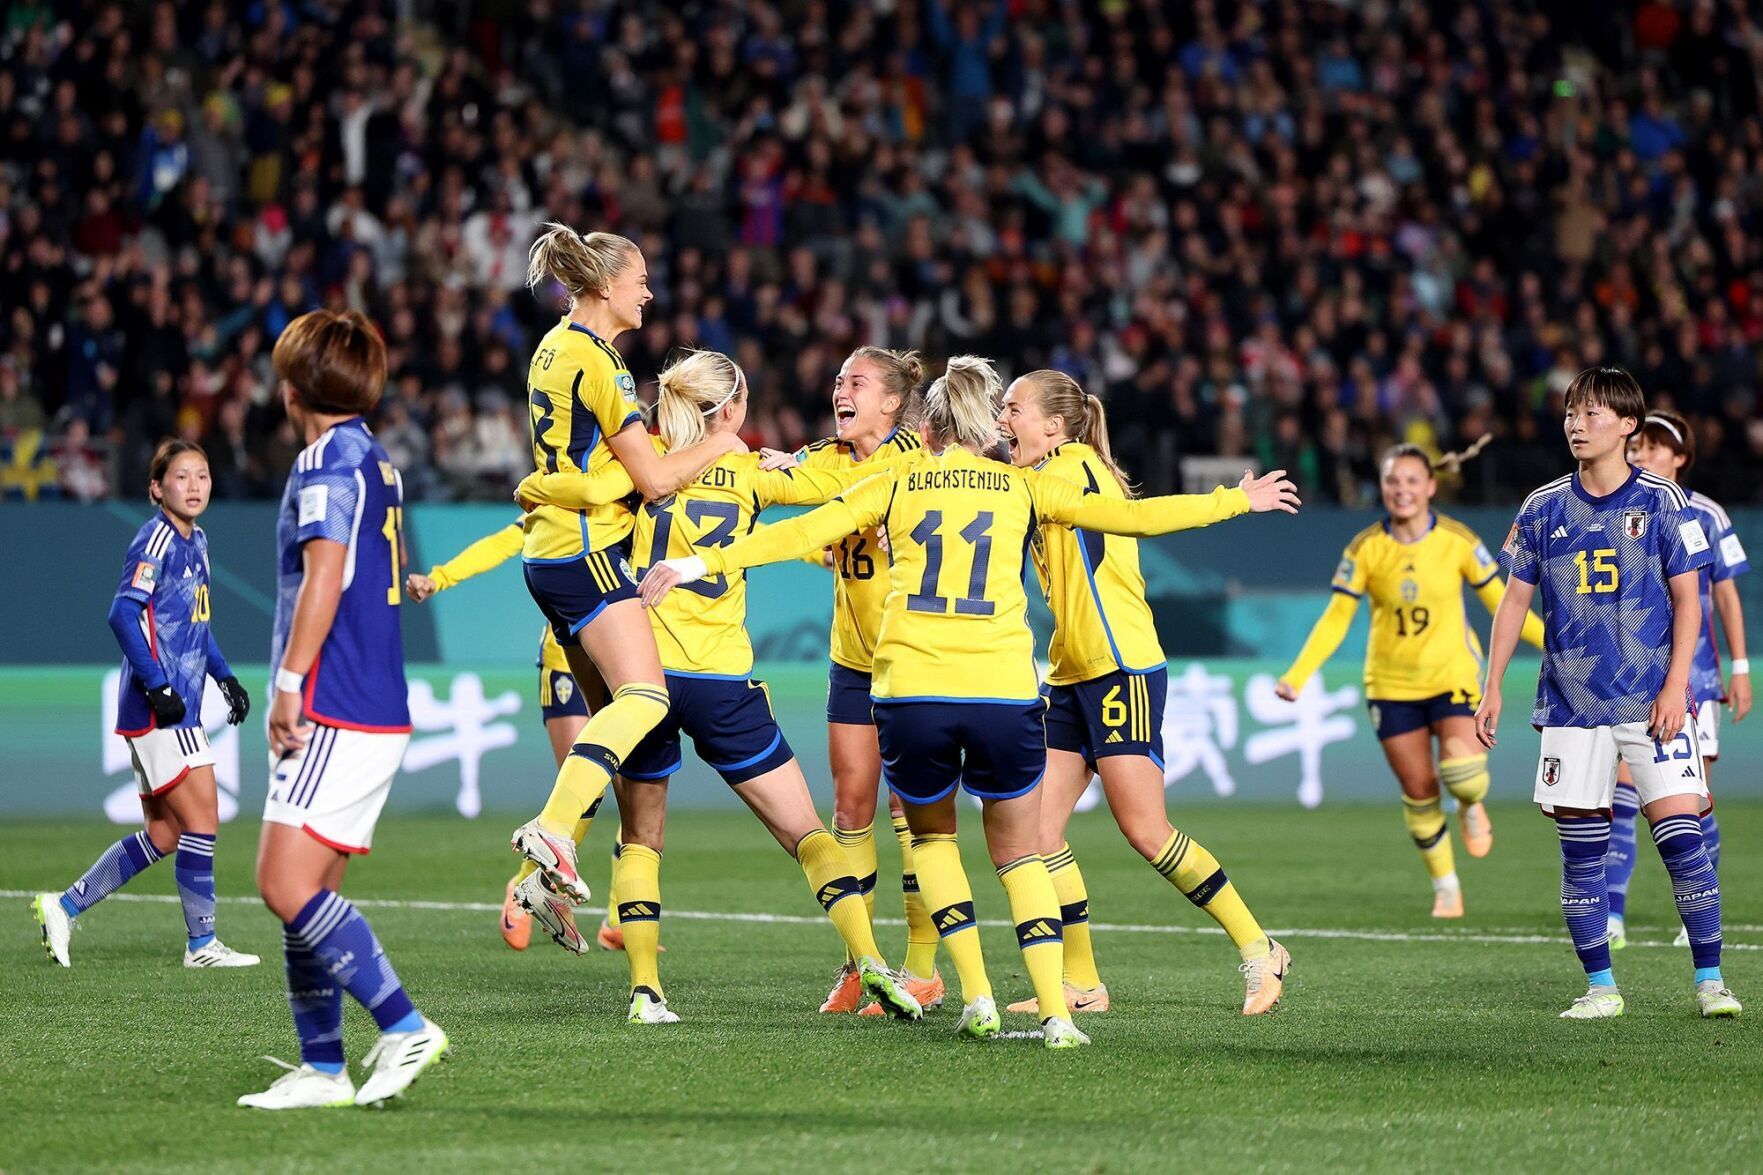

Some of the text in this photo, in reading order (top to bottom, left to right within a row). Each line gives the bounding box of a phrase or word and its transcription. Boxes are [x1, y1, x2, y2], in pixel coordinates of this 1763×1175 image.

[531, 348, 556, 371] FÖ
[691, 466, 736, 488] EDT
[908, 469, 1011, 492] BLACKSTENIUS
[636, 493, 740, 600] 13
[840, 537, 875, 580] 16
[906, 510, 996, 616] 11
[1573, 548, 1620, 594] 15
[191, 583, 210, 623] 10
[1395, 607, 1429, 637] 19
[1102, 685, 1127, 727] 6
[1676, 886, 1720, 903] JAPAN
